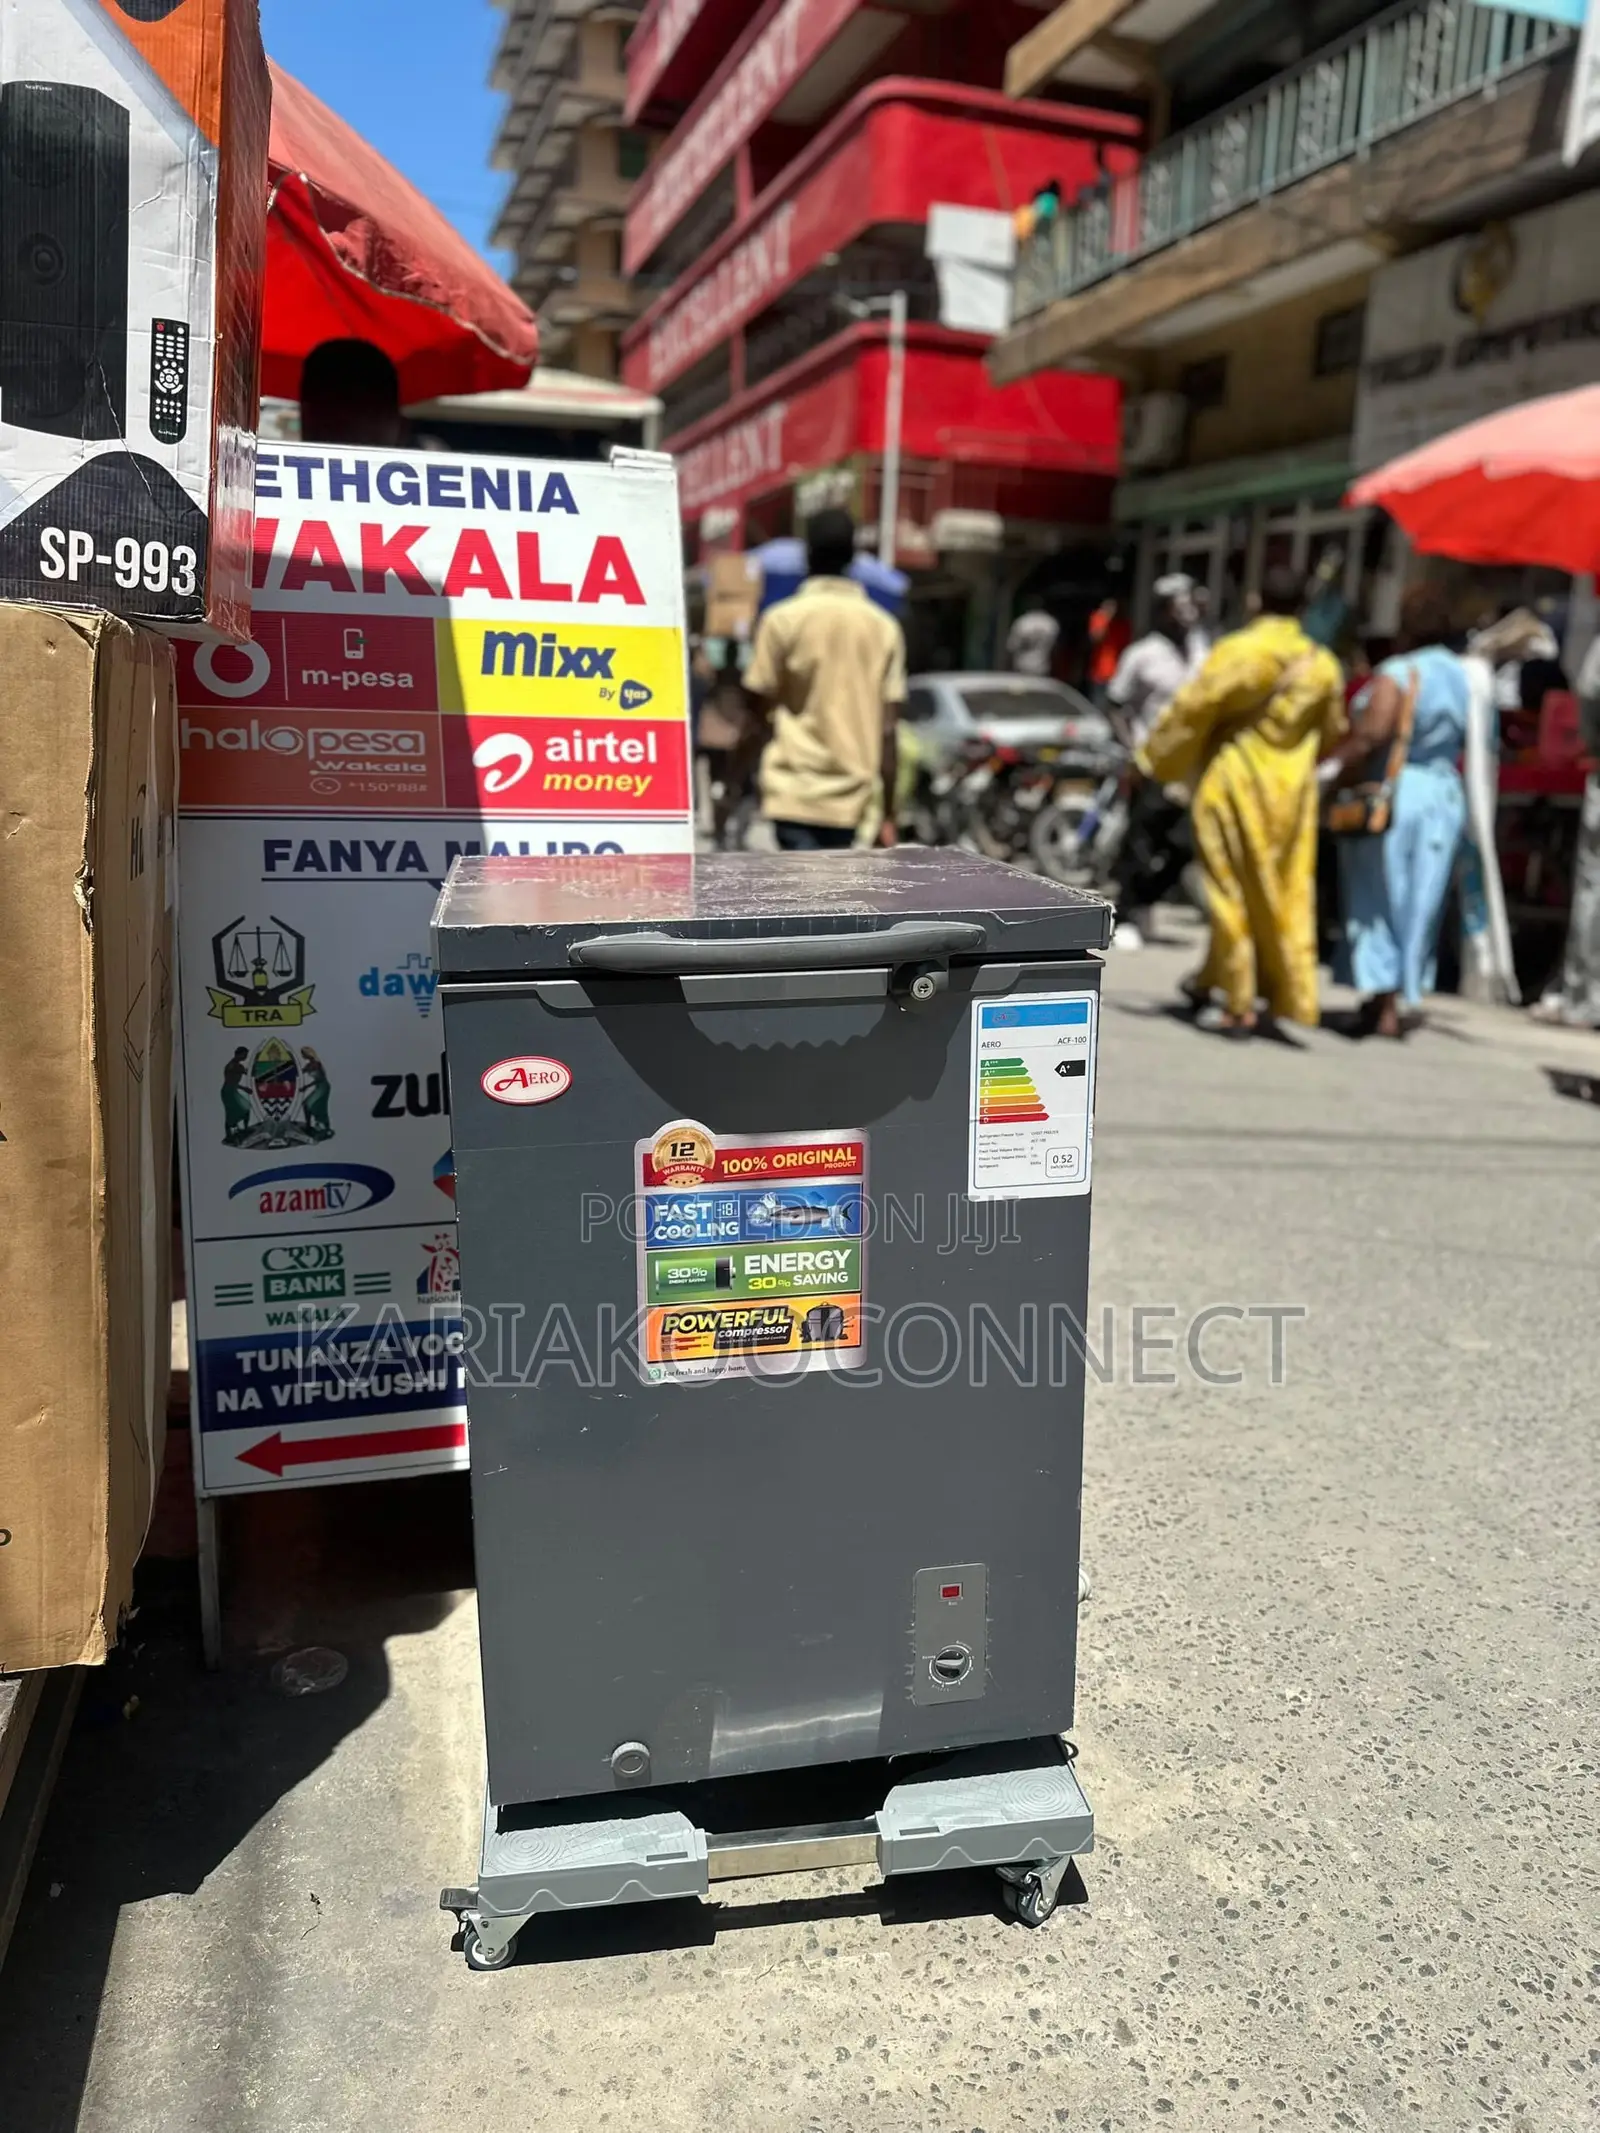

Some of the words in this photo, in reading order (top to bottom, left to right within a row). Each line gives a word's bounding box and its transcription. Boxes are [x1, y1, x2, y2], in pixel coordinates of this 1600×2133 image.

[40, 527, 197, 597] SP-993
[481, 630, 616, 679] mixx
[302, 668, 414, 690] m-pesa
[599, 687, 615, 701] By
[545, 729, 658, 764] airtel
[543, 773, 653, 797] money
[264, 839, 429, 873] FANYA
[241, 1009, 283, 1023] TRA
[981, 1041, 1001, 1049] AERO
[1058, 1036, 1087, 1045] ACF-100
[494, 1067, 560, 1092] AERO
[1059, 1064, 1070, 1074] A+
[670, 1142, 695, 1157] 12
[1052, 1154, 1072, 1164] 0.52
[662, 1165, 706, 1176] WARRANTY
[721, 1156, 767, 1174] 100%
[772, 1147, 857, 1169] ORIGINAL
[824, 1160, 856, 1170] PRODUCT
[259, 1181, 352, 1214] azamtv
[654, 1202, 712, 1222] FAST
[654, 1221, 739, 1240] COOLING
[261, 1243, 344, 1272] CRDB
[744, 1249, 852, 1276] ENERGY
[667, 1268, 708, 1279] 30%
[748, 1276, 790, 1290] 30%
[793, 1271, 849, 1287] SAVING
[269, 1275, 343, 1297] BANK
[265, 1307, 349, 1327] WAKALA
[664, 1307, 791, 1333] POWERFUL
[718, 1325, 788, 1338] compressor
[236, 1339, 395, 1374] TUNAUZA
[707, 1366, 727, 1376] happy
[216, 1387, 263, 1412] NA
[272, 1368, 447, 1407] VIFURUSHI
